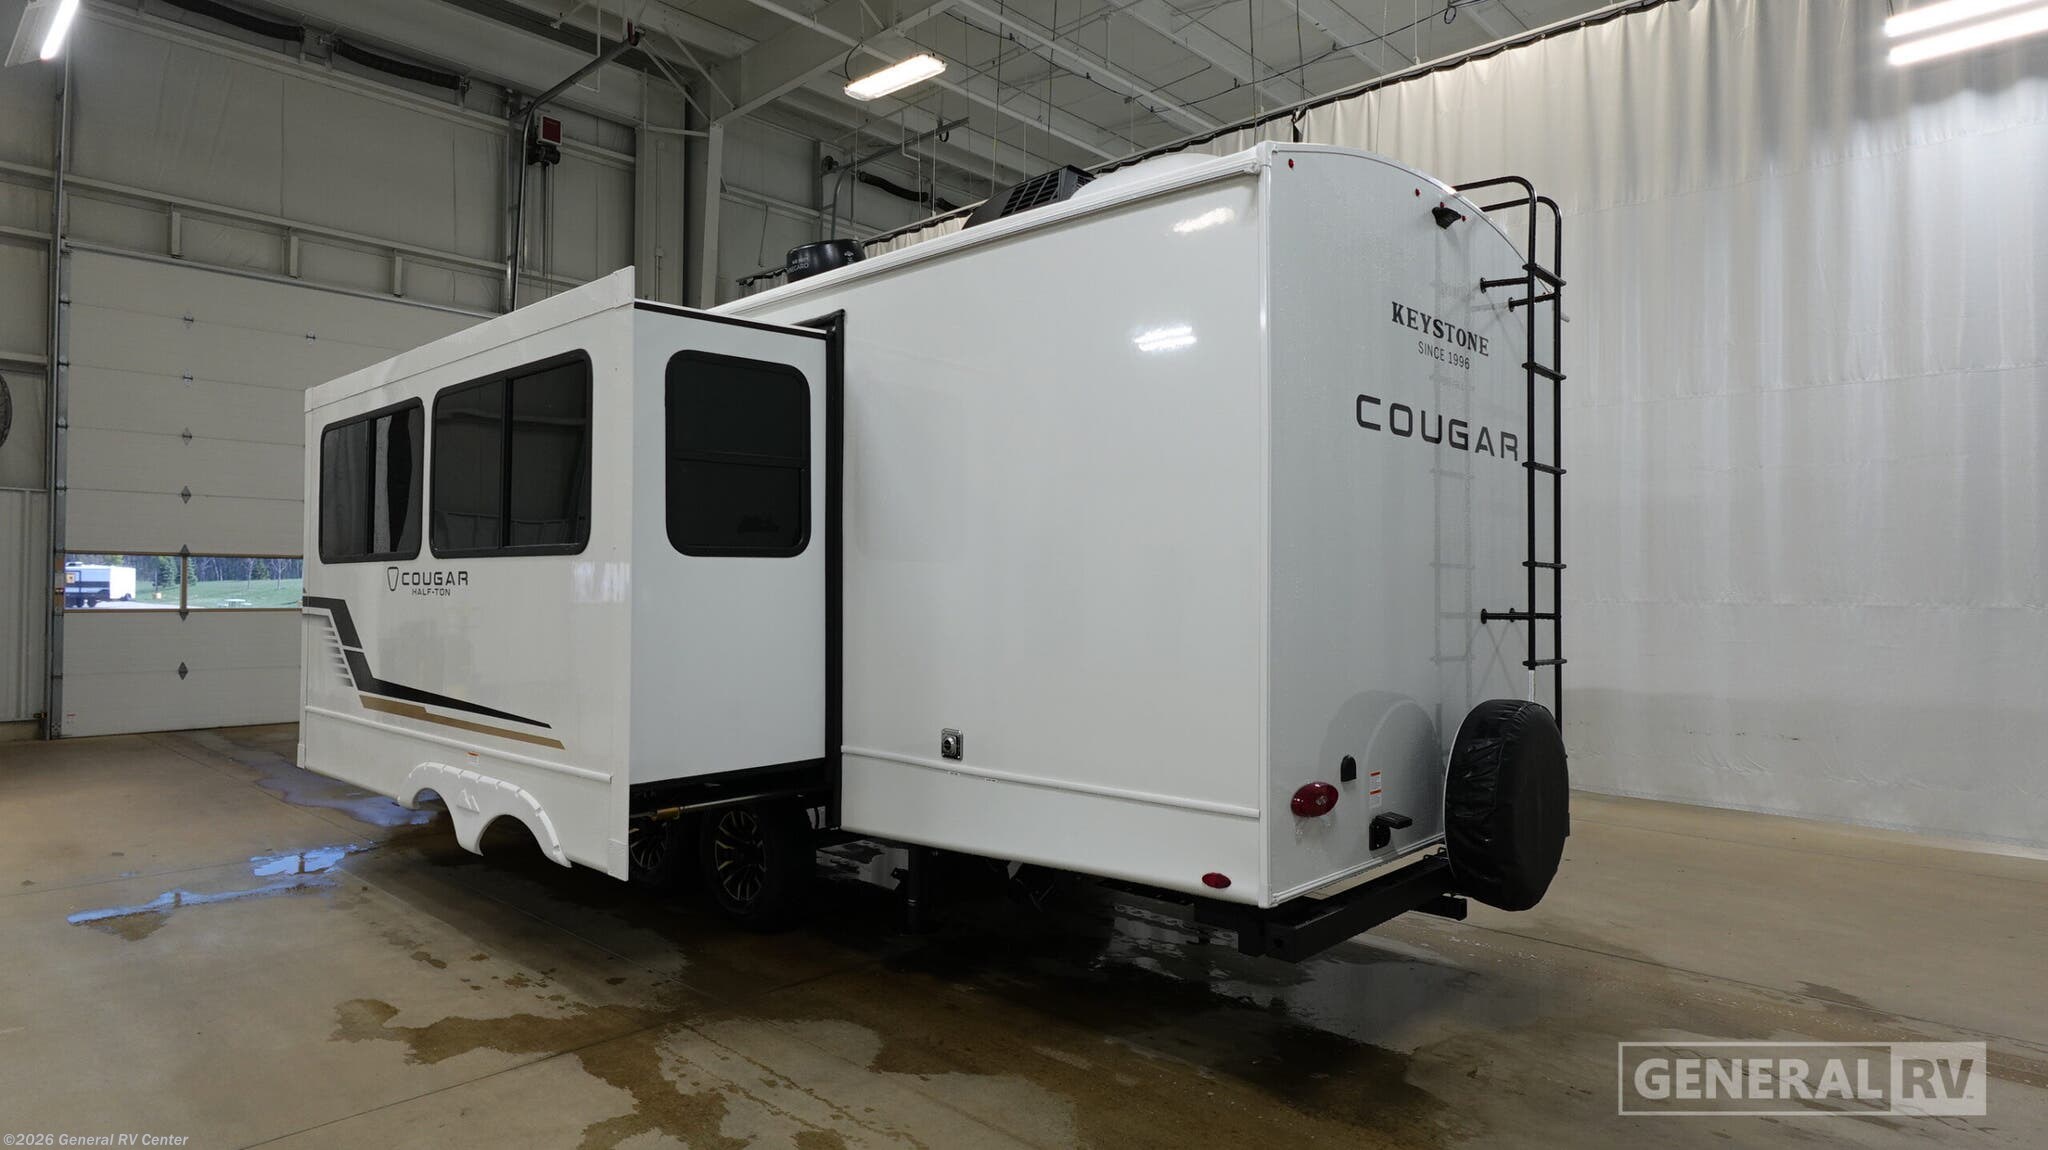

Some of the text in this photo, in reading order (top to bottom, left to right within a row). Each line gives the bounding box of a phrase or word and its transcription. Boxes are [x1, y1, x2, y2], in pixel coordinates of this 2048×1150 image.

[1391, 301, 1489, 356] KEYSTONE
[1418, 341, 1470, 370] SINCE 1996
[1356, 394, 1518, 461] COUGAR
[402, 571, 468, 586] COUGAR
